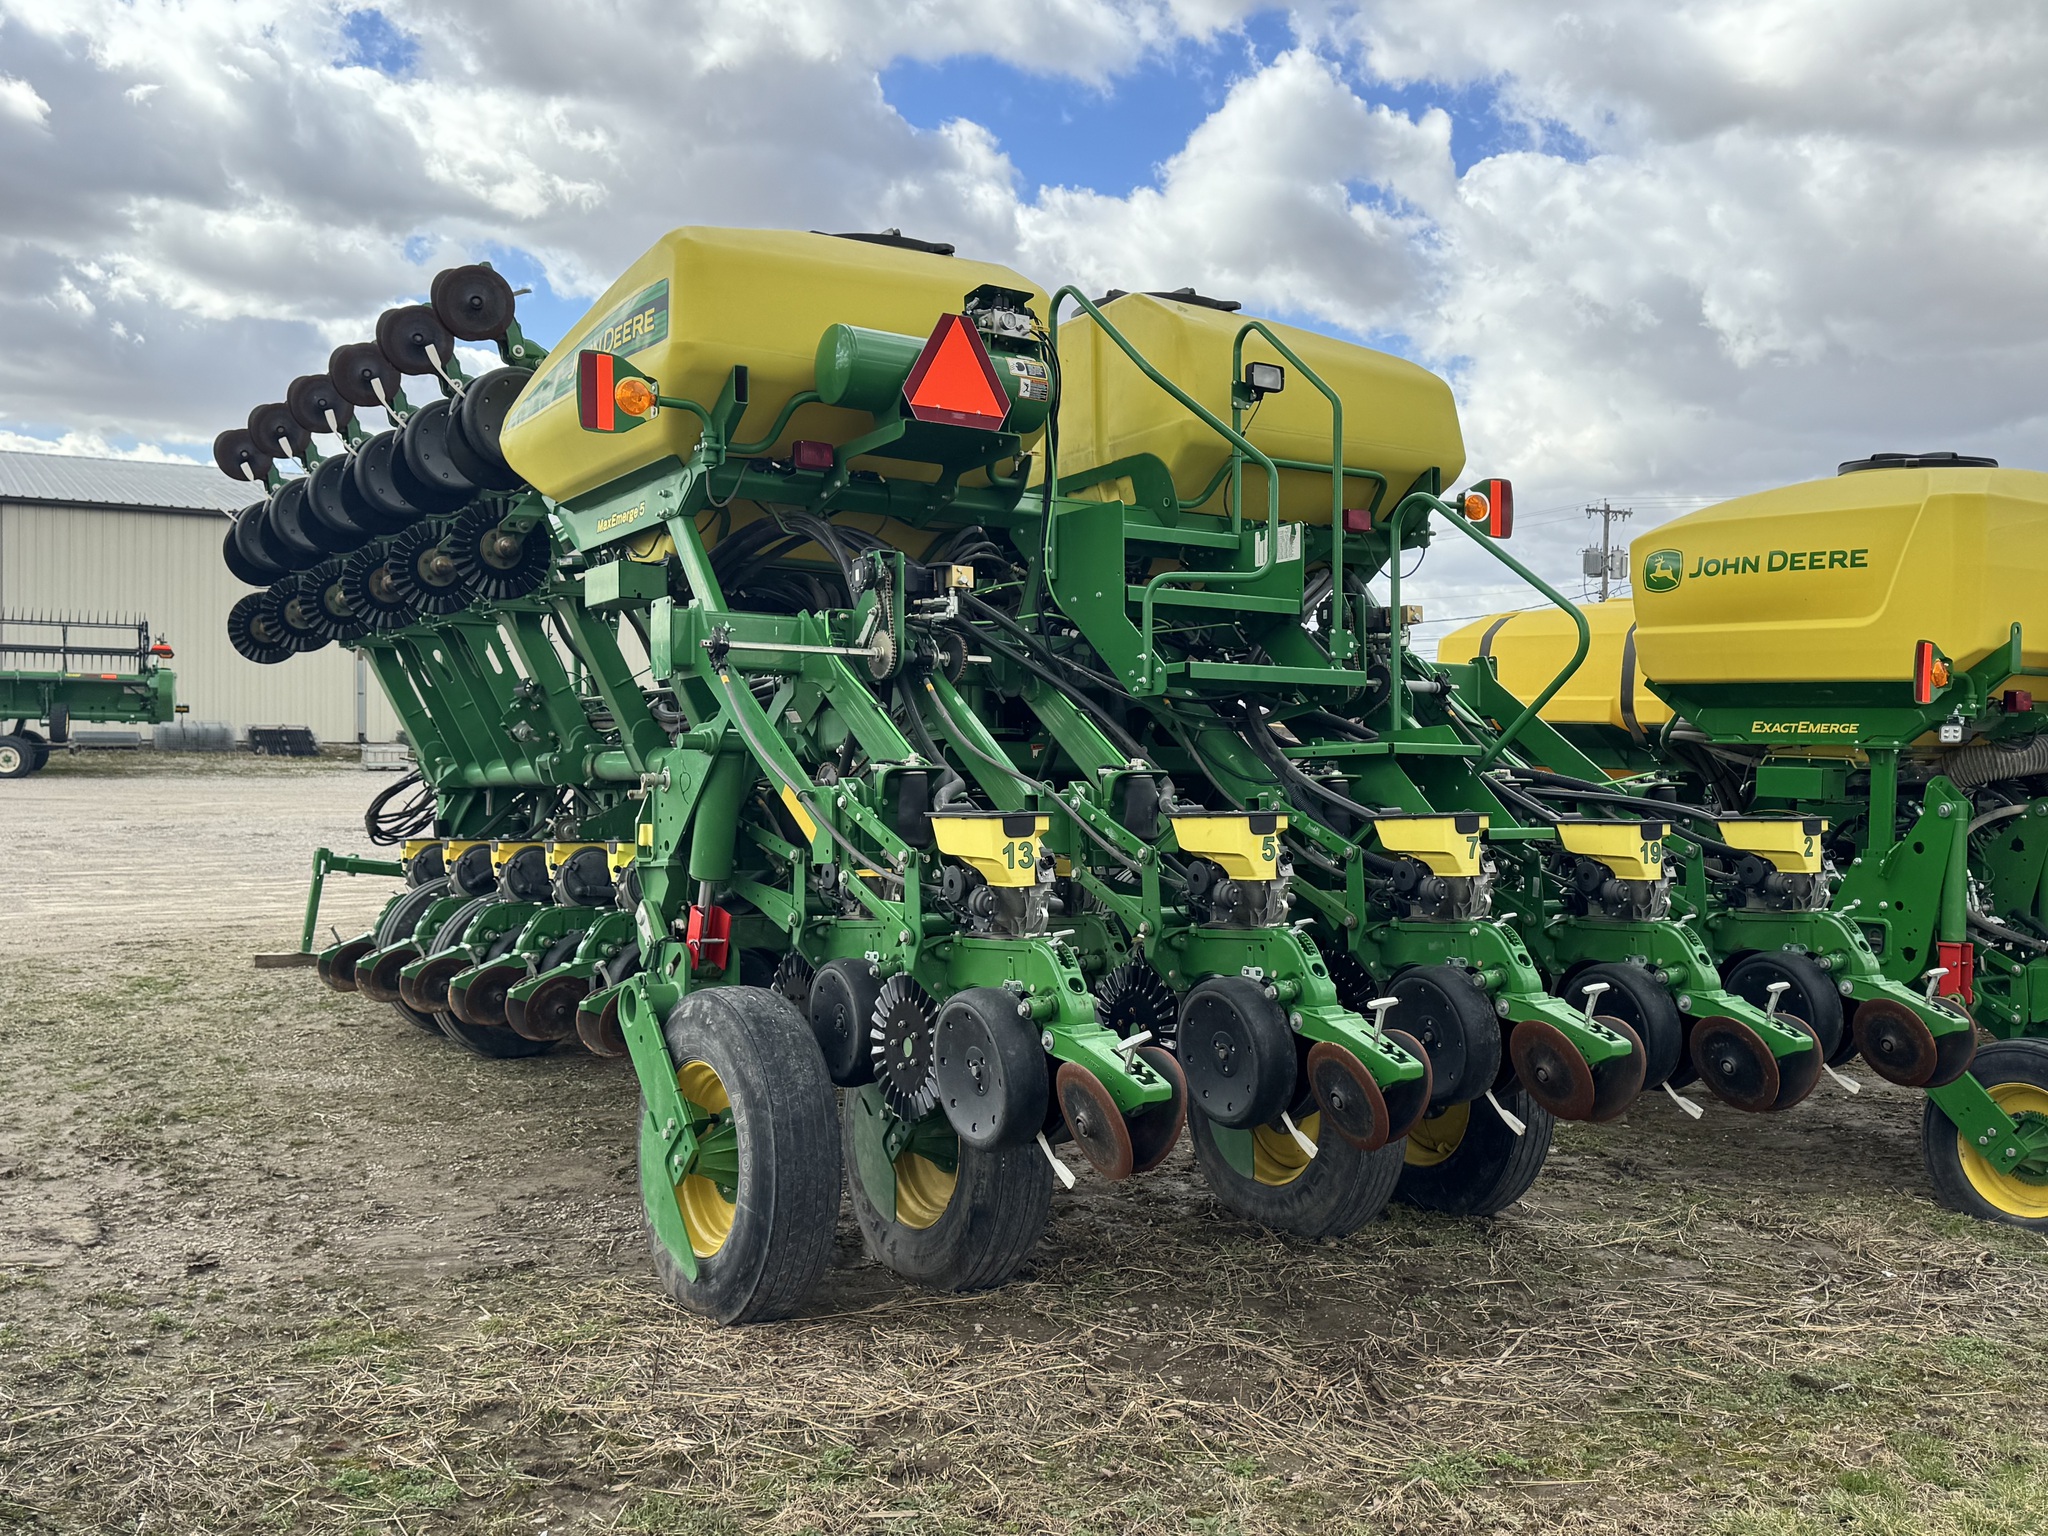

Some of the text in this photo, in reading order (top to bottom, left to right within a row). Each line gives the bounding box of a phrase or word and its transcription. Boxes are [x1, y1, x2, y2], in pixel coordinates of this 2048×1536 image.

[603, 307, 656, 354] DEERE
[596, 500, 645, 534] MaxEmerge 5
[1688, 548, 1869, 579] JOHN DEERE
[1002, 841, 1035, 869] 13
[1262, 836, 1276, 862] 5
[1466, 836, 1479, 859] 7
[1640, 841, 1661, 864] 19
[1803, 836, 1813, 857] 2
